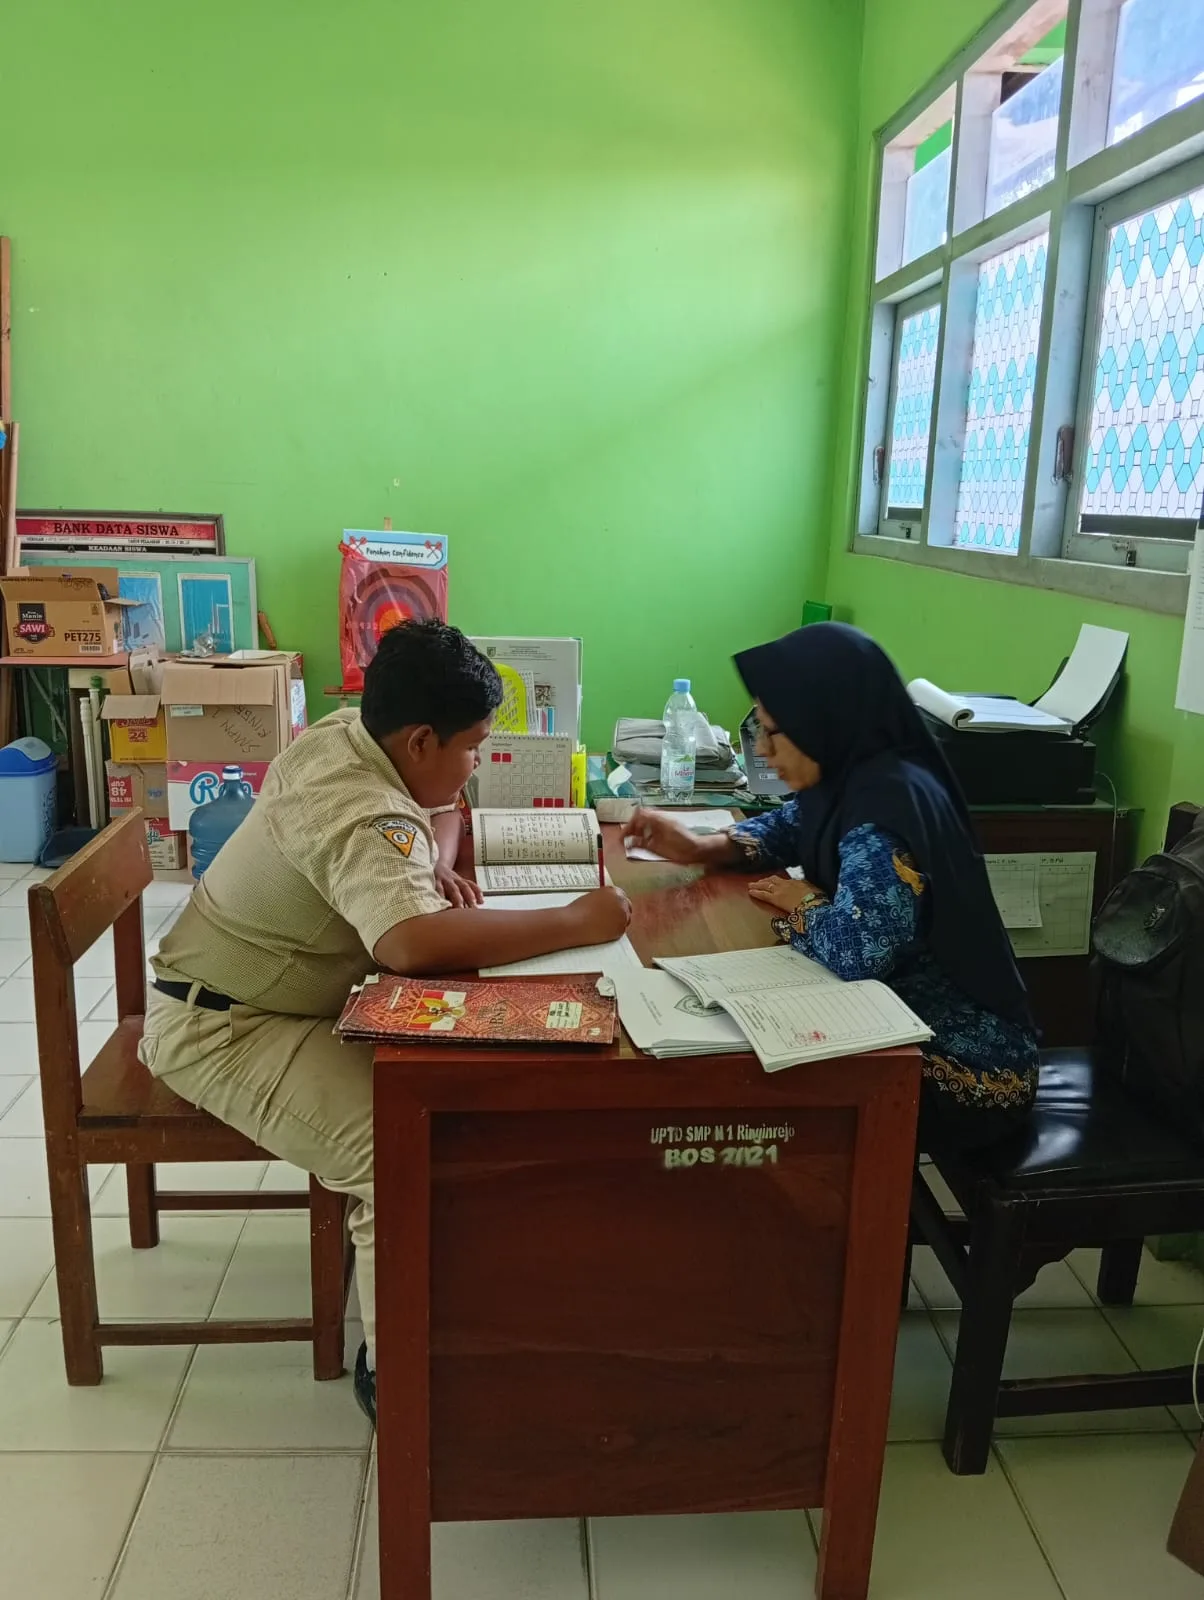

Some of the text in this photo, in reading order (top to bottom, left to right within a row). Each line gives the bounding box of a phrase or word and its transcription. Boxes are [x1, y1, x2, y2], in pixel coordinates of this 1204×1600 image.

[54, 522, 179, 536] BANK DATA SISWA
[20, 624, 46, 633] SAWI
[64, 632, 102, 642] PET275
[129, 731, 148, 740] 24
[111, 786, 128, 797] 48
[650, 1122, 796, 1144] UPTD SMP N 1 Ringinrejo
[664, 1146, 716, 1169] BOS
